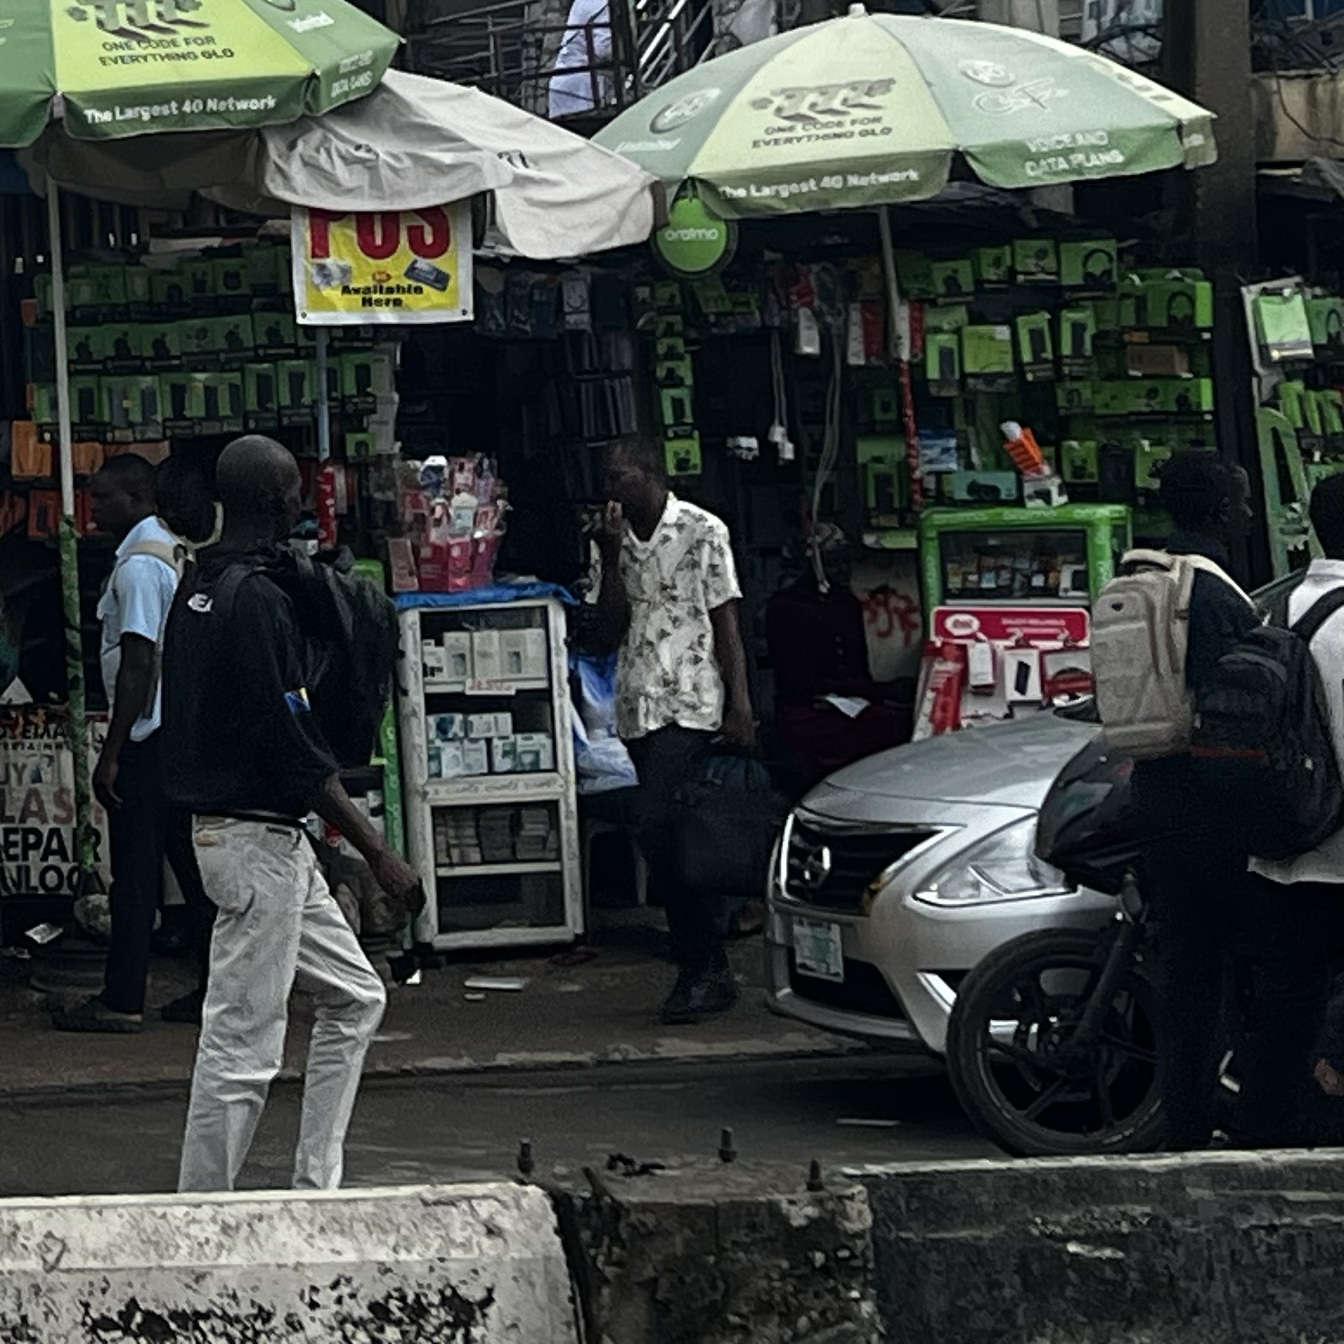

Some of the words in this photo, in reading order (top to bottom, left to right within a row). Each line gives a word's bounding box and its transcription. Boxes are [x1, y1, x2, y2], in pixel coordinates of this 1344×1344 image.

[101, 39, 135, 52] ONE
[137, 36, 182, 50] CODE
[183, 35, 216, 46] FOR
[98, 52, 198, 67] EVERYTHING
[83, 108, 112, 124] The
[115, 101, 178, 122] Largest
[206, 95, 277, 113] Network
[751, 131, 855, 149] EVERYTHING
[749, 177, 818, 199] Largest
[846, 169, 920, 187] Network
[664, 227, 720, 242] oraimo
[341, 284, 424, 296] Available
[361, 296, 404, 307] Here
